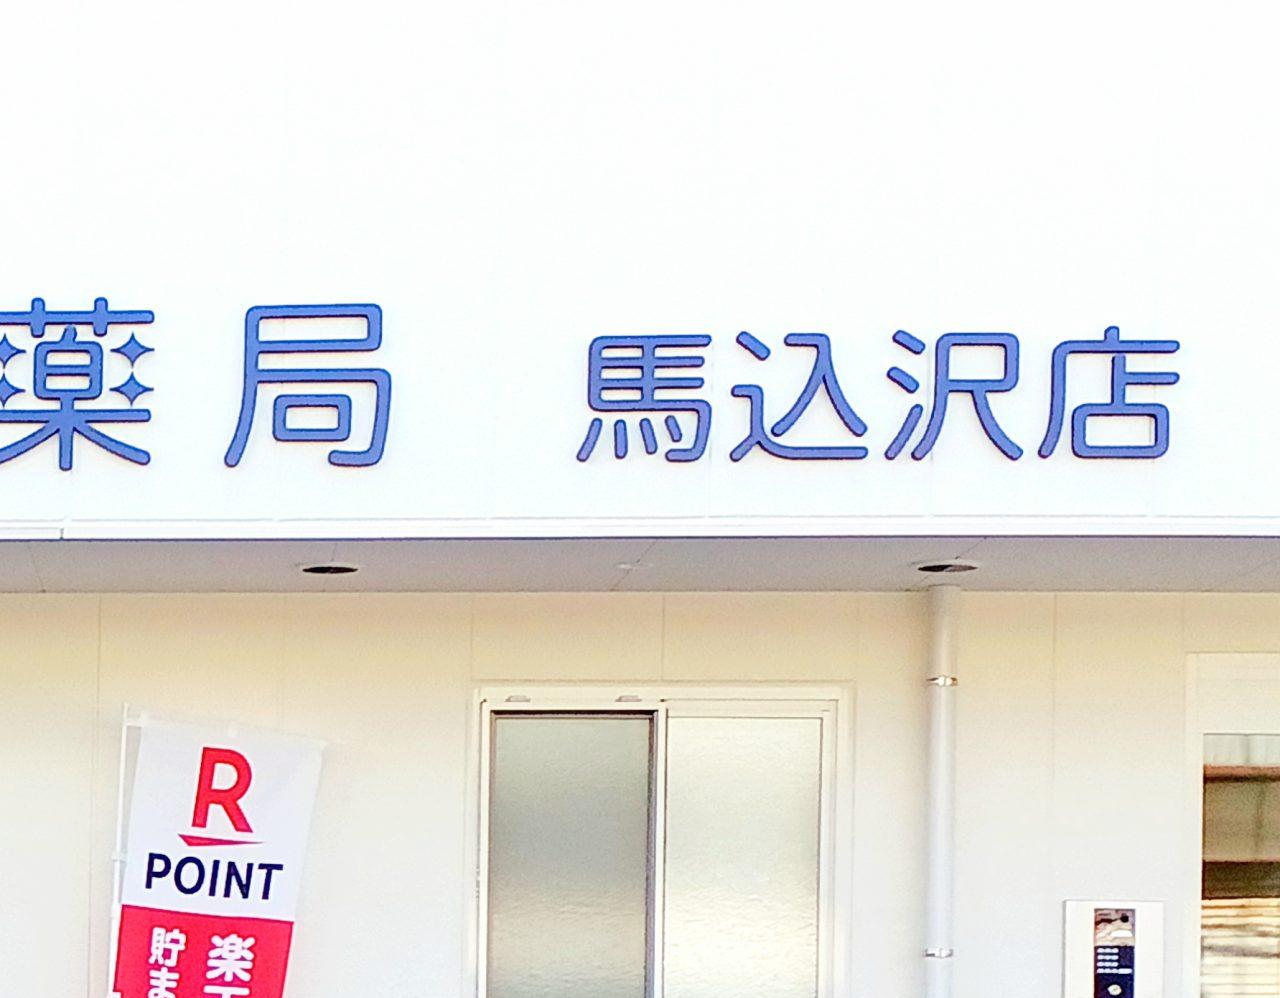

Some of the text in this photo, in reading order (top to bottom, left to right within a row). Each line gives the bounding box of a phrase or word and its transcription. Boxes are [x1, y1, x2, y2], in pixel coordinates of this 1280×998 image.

[577, 325, 1181, 462] 馬込沢店
[191, 746, 254, 834] R
[145, 852, 284, 901] POINT
